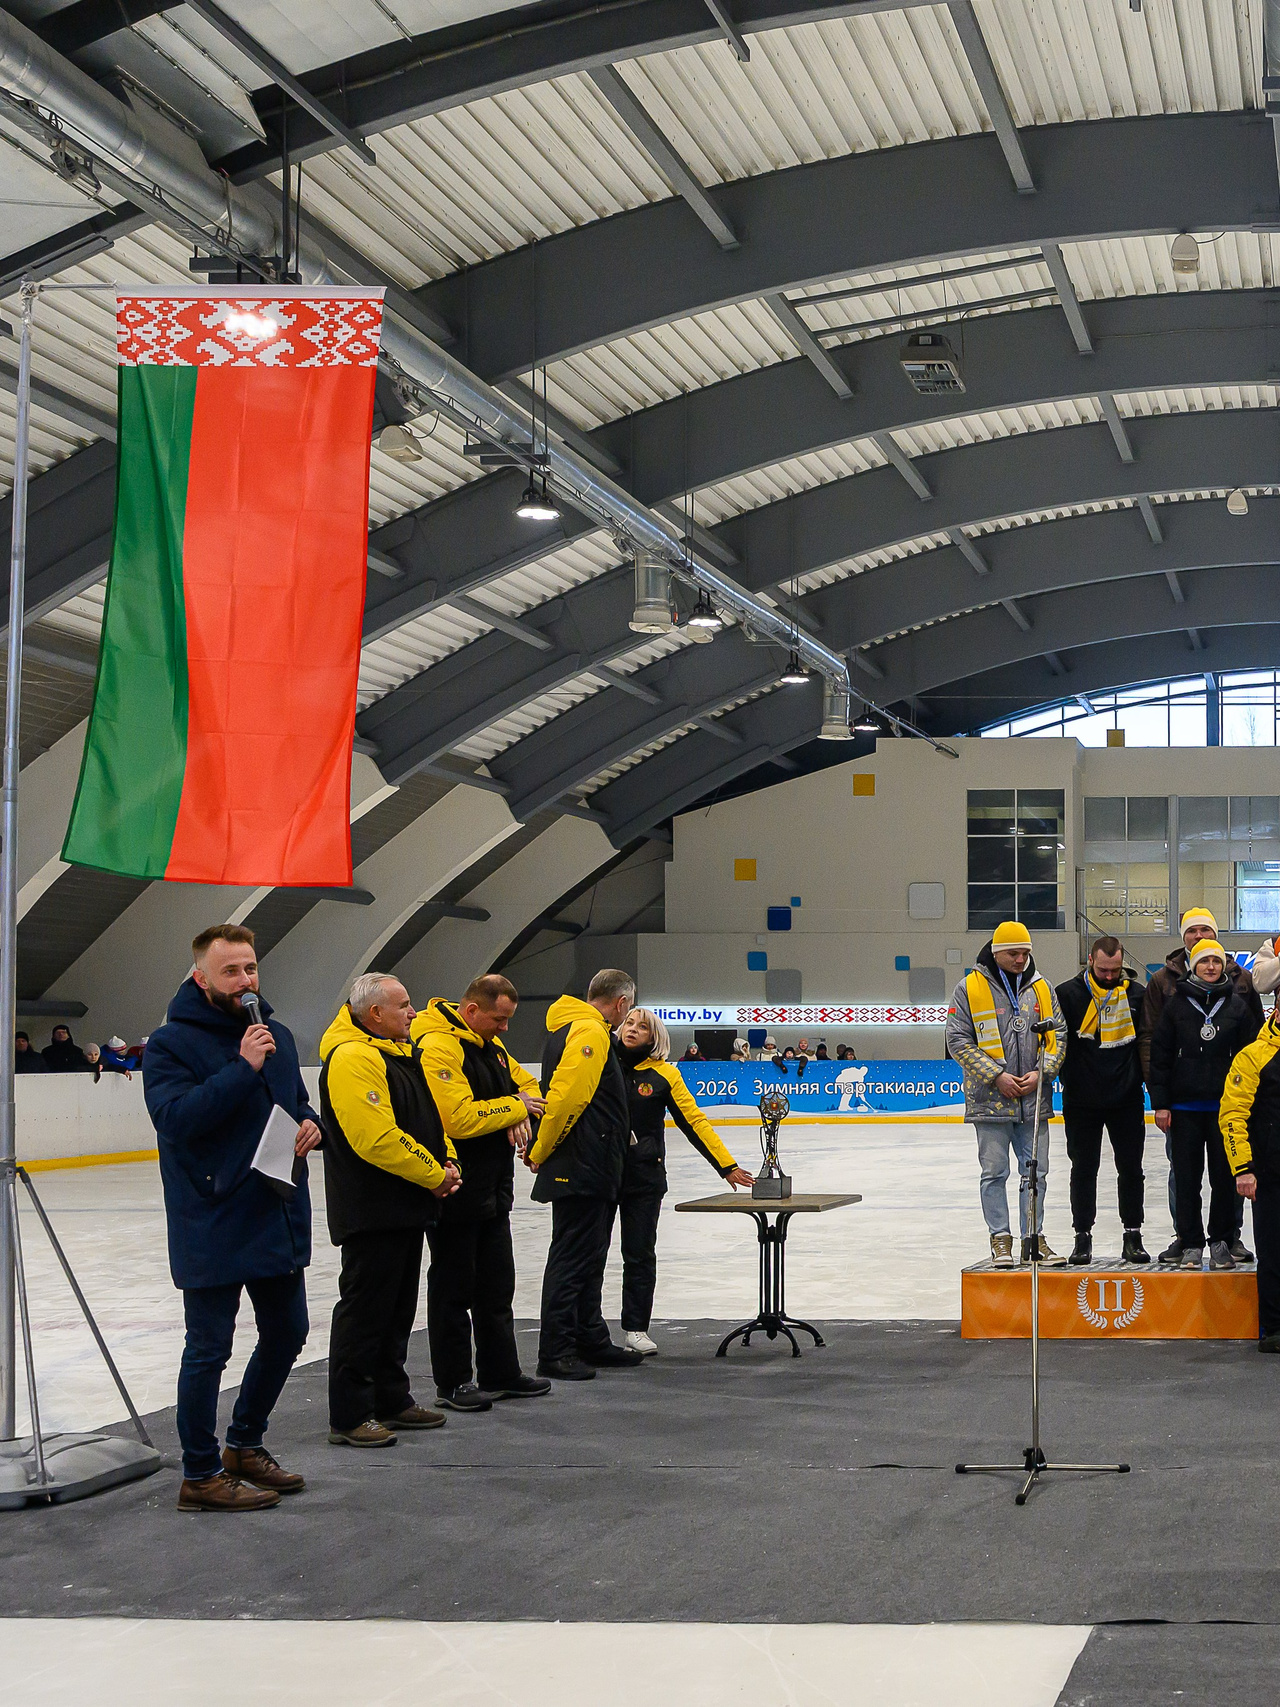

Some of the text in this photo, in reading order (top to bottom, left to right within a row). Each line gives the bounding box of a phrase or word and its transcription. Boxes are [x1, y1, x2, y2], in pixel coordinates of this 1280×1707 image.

[654, 1008, 723, 1022] ilichy.by
[696, 1080, 738, 1096] 2026
[753, 1079, 820, 1096] Зимняя
[824, 1081, 936, 1098] спартакиада
[1094, 1279, 1126, 1311] II
